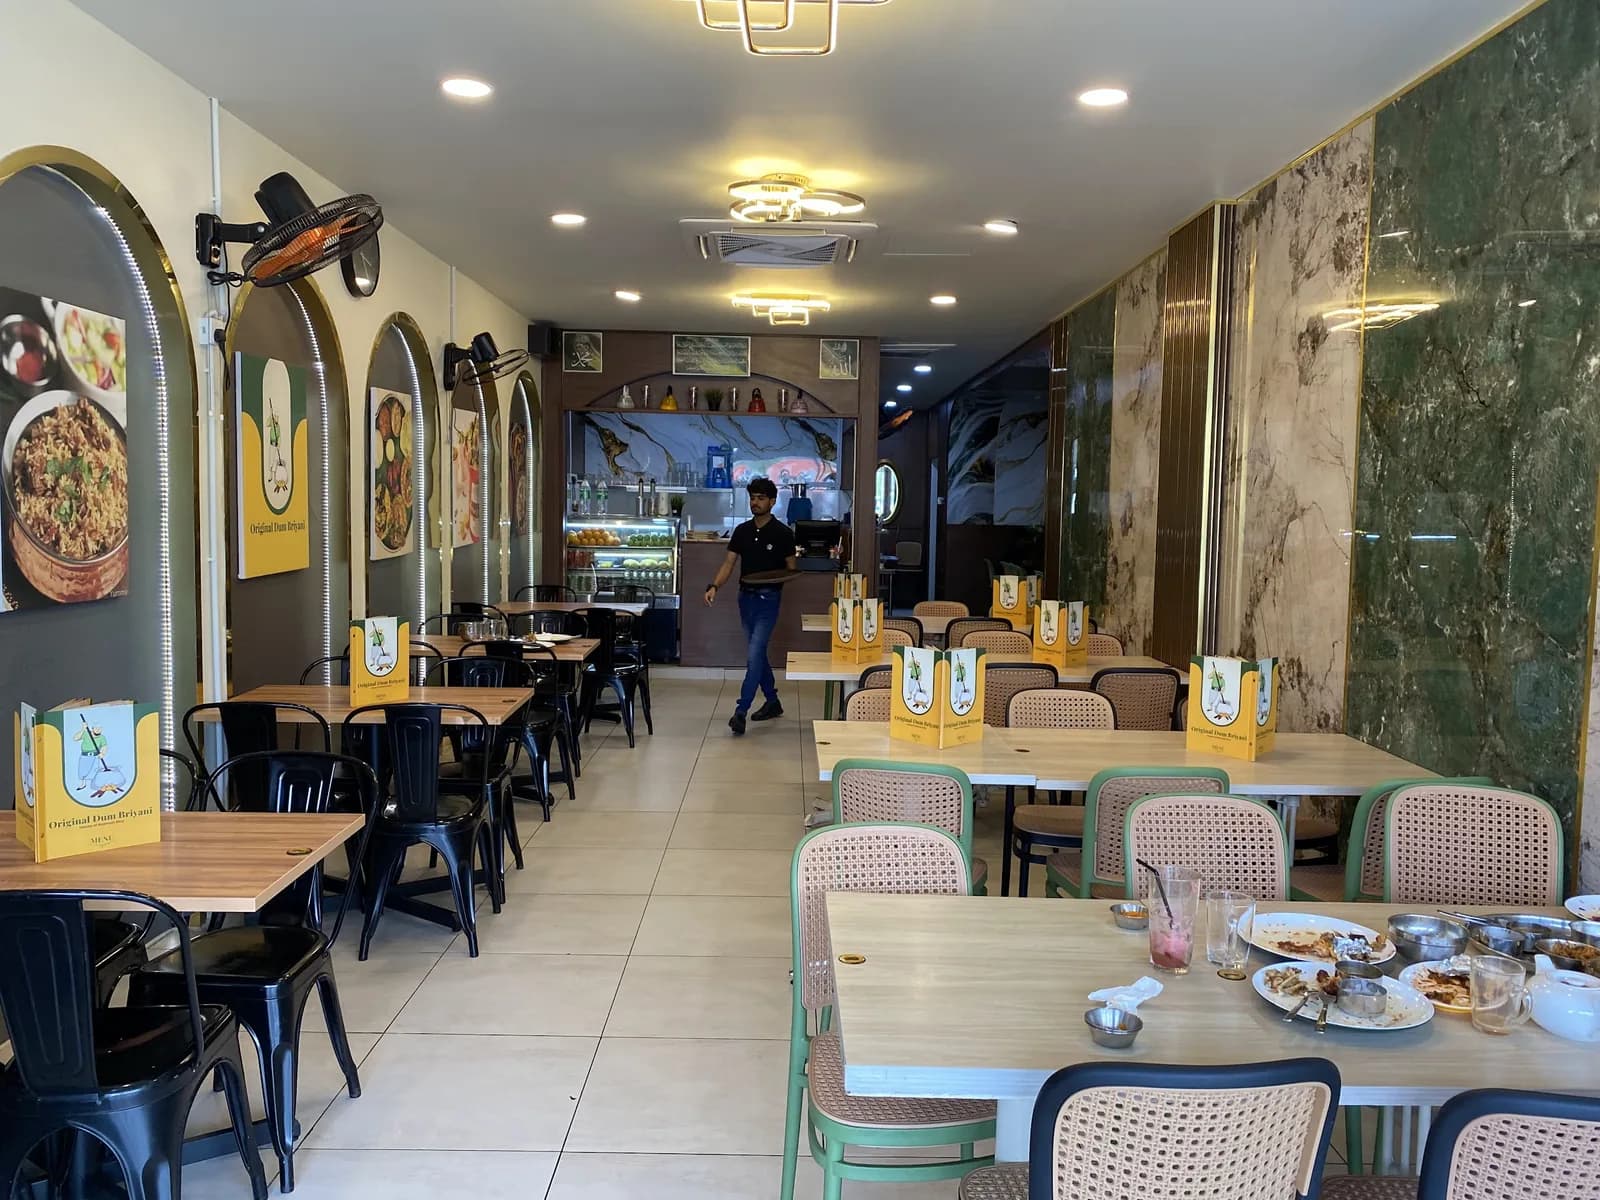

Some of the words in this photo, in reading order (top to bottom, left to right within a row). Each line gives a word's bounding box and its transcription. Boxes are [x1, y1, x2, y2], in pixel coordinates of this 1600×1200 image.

[250, 522, 273, 536] Original
[274, 522, 287, 532] Dum
[287, 520, 305, 533] Briyani
[1191, 726, 1213, 735] Original
[48, 815, 90, 830] Original
[92, 813, 116, 823] Dum
[118, 807, 153, 819] Briyani
